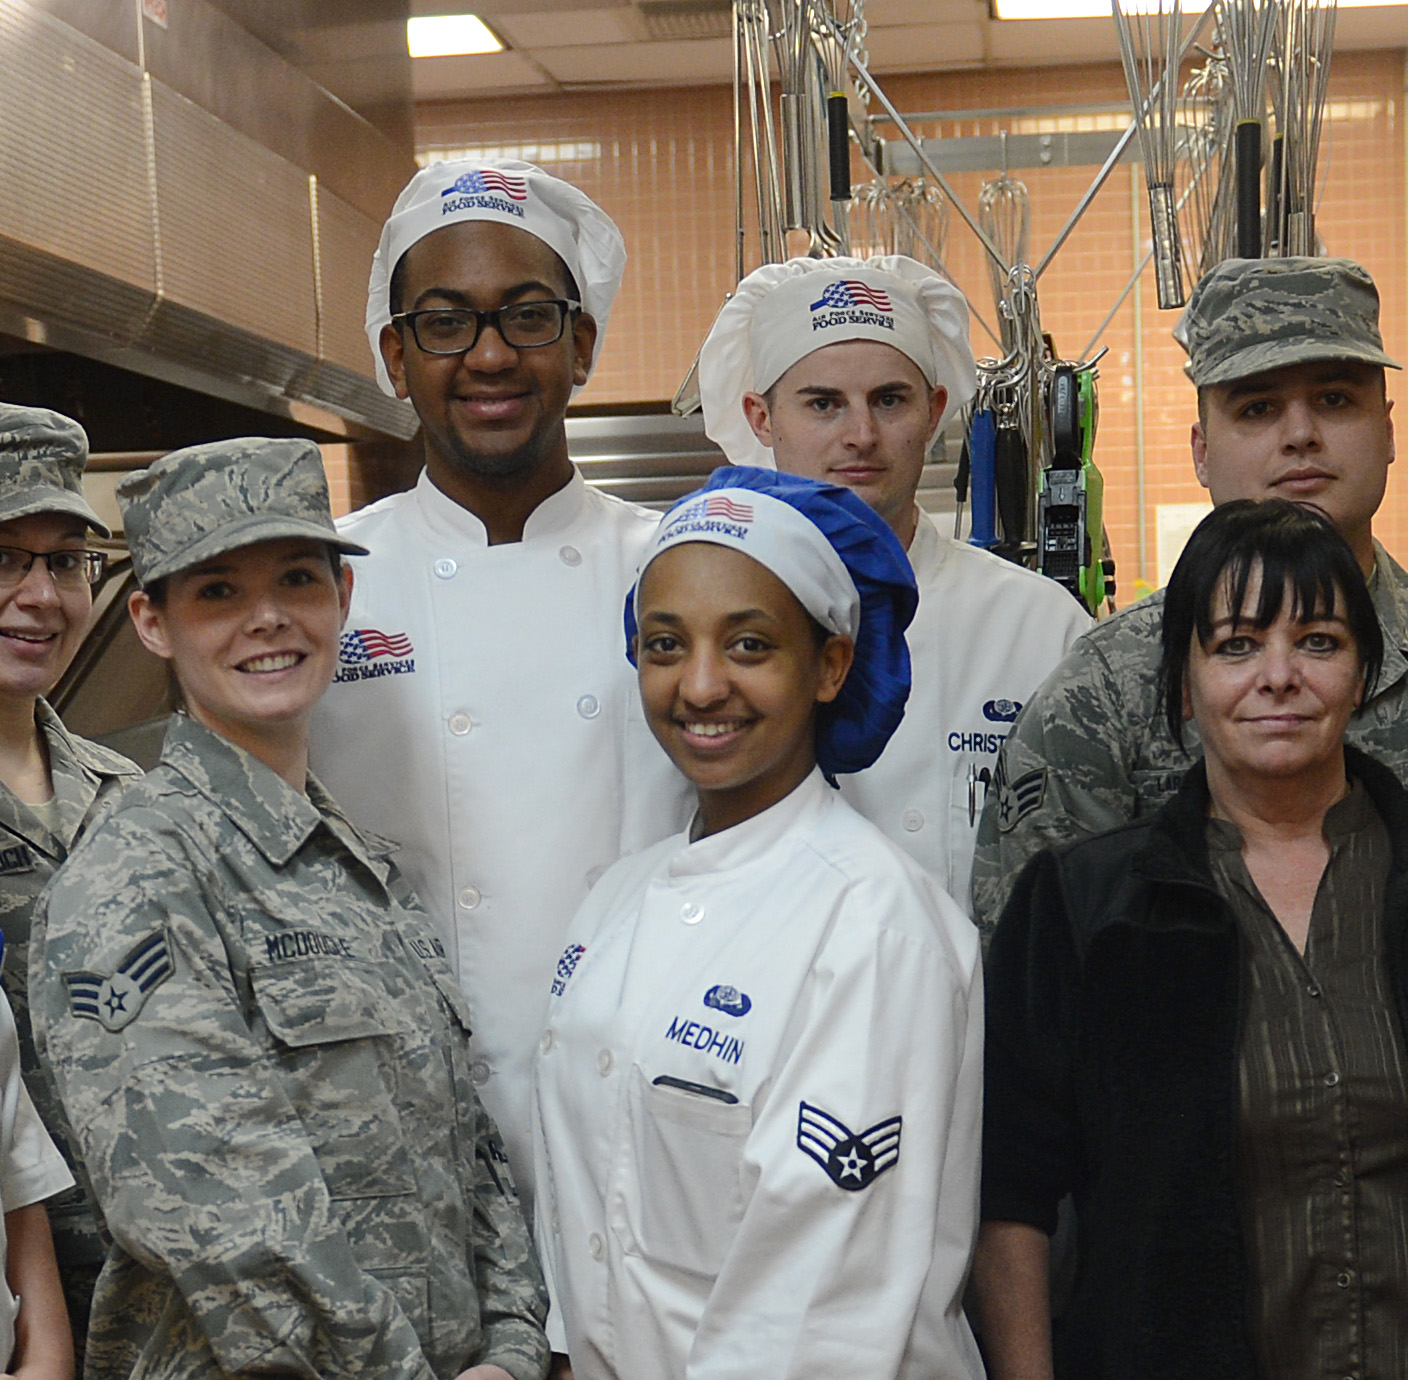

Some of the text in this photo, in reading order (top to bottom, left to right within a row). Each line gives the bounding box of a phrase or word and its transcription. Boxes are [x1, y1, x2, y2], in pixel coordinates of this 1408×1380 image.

[442, 201, 475, 216] FOOD
[812, 316, 895, 331] FOOD SERVICE
[665, 1016, 745, 1065] MEDHIN
